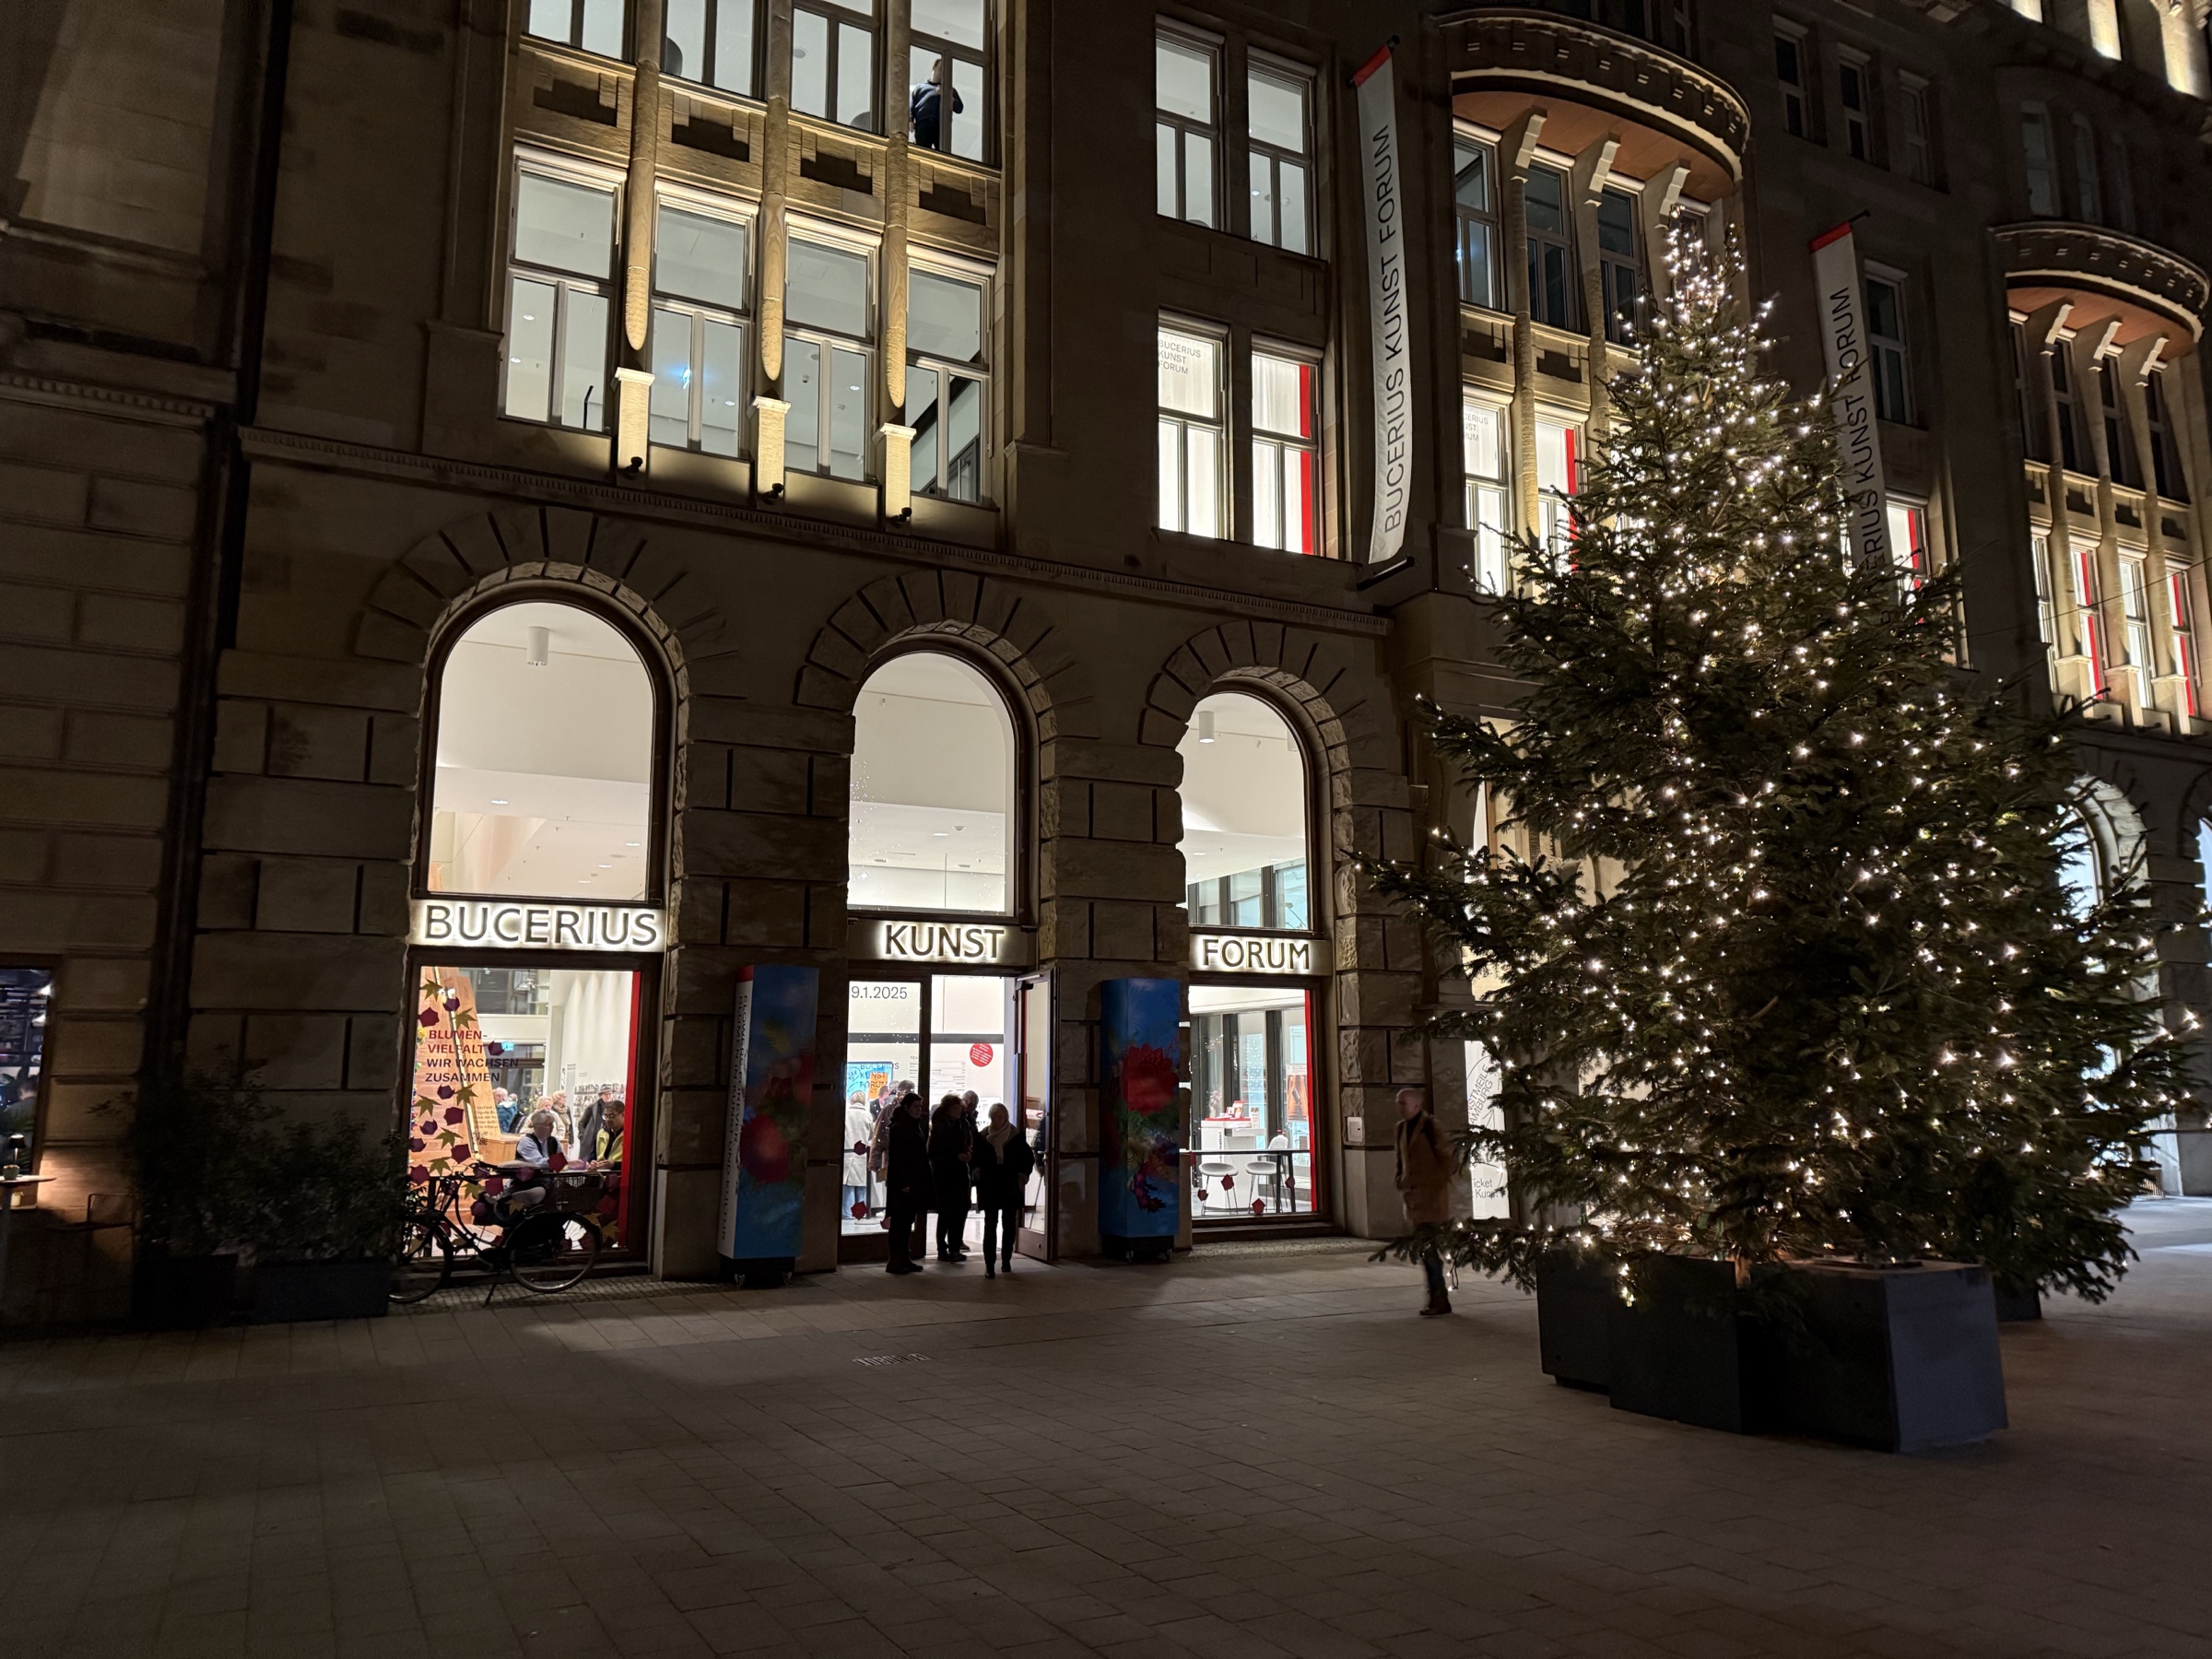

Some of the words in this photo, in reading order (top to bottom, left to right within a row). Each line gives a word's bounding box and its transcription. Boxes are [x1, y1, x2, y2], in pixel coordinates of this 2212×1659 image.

[1372, 124, 1396, 244] FORUM
[1381, 253, 1403, 361] KUNST
[1159, 339, 1202, 358] BUCERIUS
[1159, 350, 1187, 364] KUNST
[1384, 367, 1405, 534] BUCERIUS
[1844, 394, 1875, 483] KUNST
[425, 905, 658, 947] BUCERIUS
[885, 924, 1005, 959] KUNST
[1202, 938, 1310, 971] FORUM
[851, 985, 908, 1000] 9.1.2025
[429, 1030, 488, 1040] BLUMEN-
[735, 995, 743, 1059] BLUMEN
[428, 1044, 485, 1053] VIELFALT
[427, 1058, 452, 1067] WIR
[455, 1058, 519, 1067] WACHSEN
[734, 1065, 739, 1080] IN
[425, 1073, 500, 1083] ZUSAMMEN
[1473, 1177, 1493, 1188] icket
[721, 1180, 730, 1241] KULTUR
